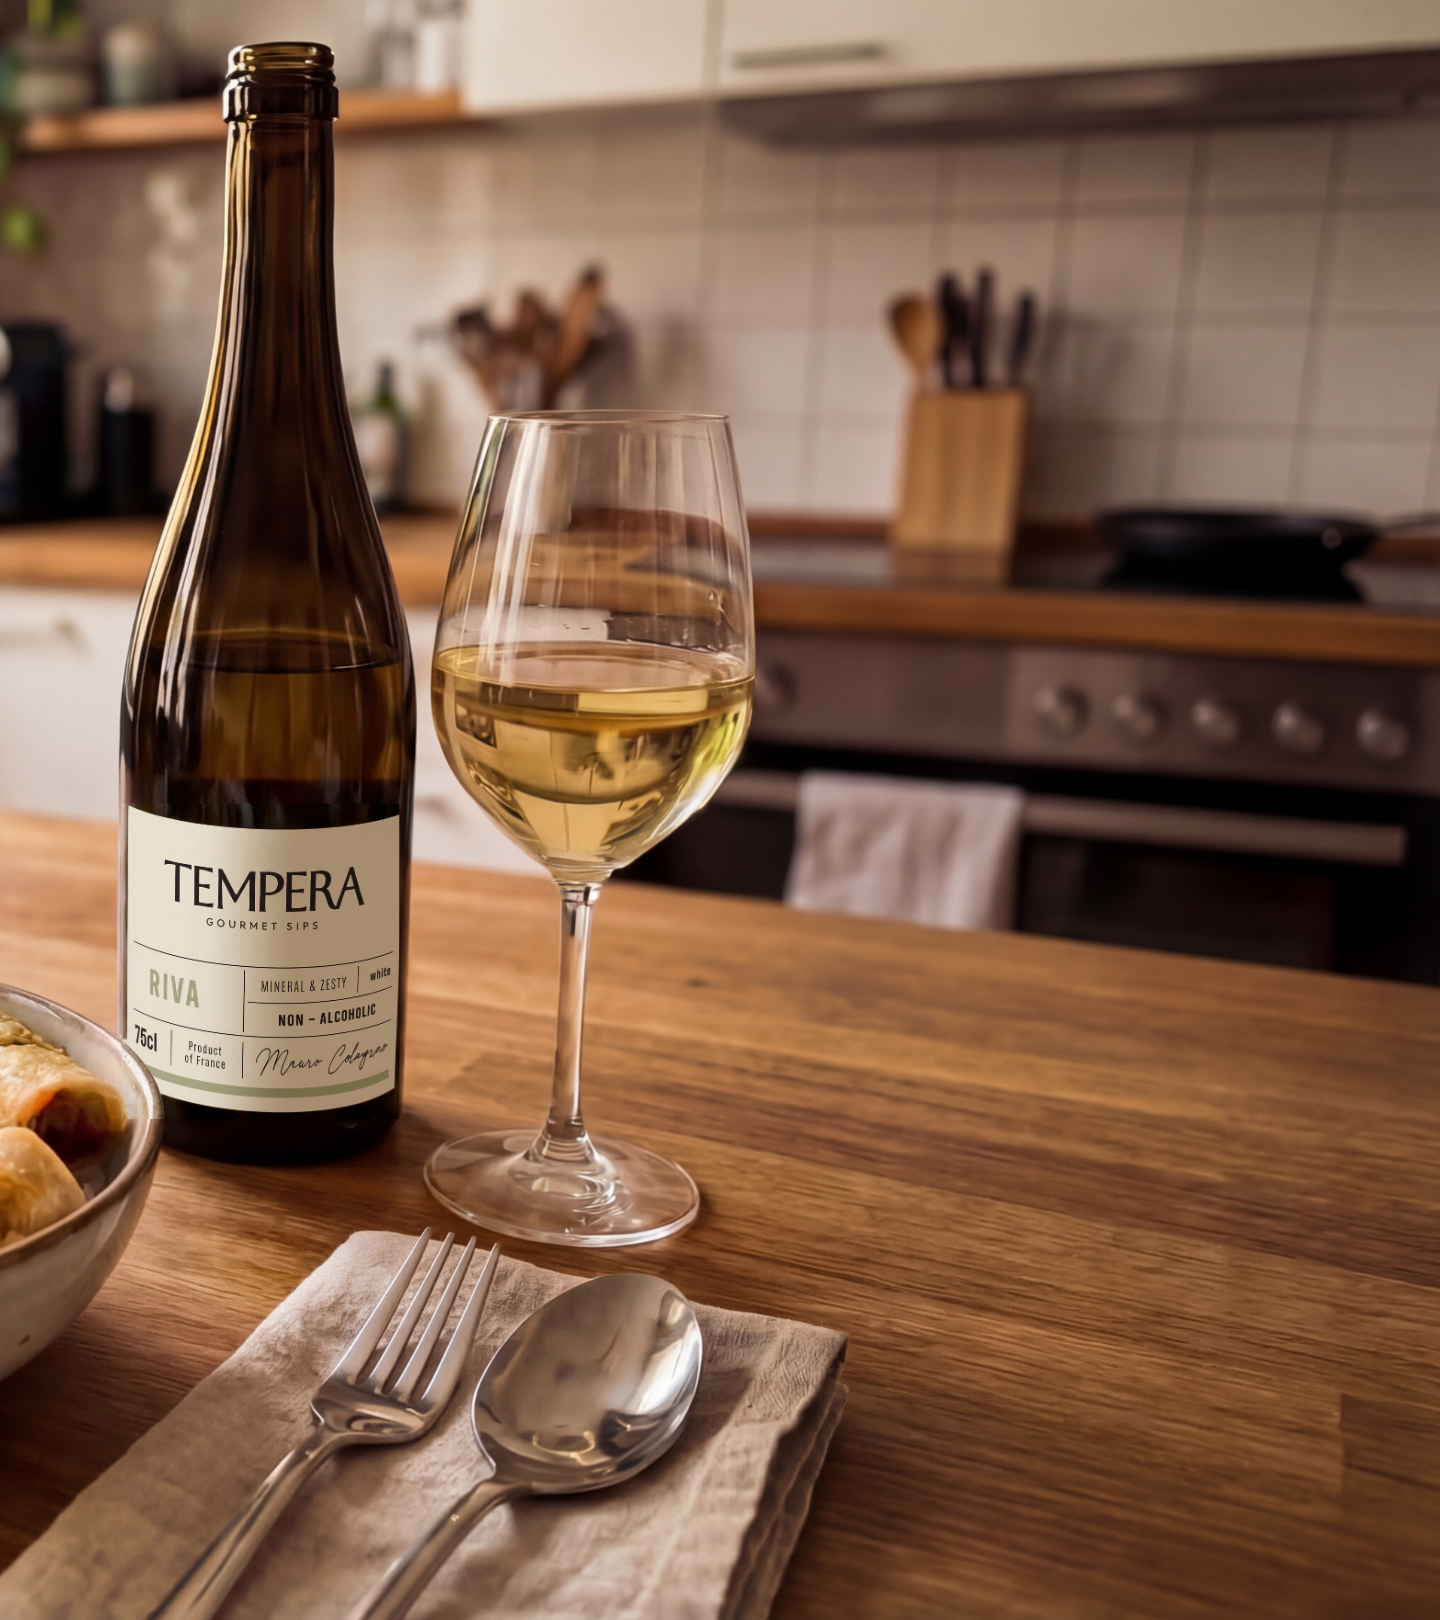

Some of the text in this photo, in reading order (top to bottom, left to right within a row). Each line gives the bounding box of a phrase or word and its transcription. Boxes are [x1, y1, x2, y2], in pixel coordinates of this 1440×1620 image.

[164, 859, 365, 913] TEMPERA
[206, 917, 319, 931] GOURMET SIPS
[370, 967, 391, 981] white
[149, 968, 200, 1008] RIVA
[260, 976, 347, 993] MINERAL & ZESTY
[278, 1014, 304, 1027] NON
[319, 1003, 376, 1025] ALCOHOLIC
[134, 1023, 158, 1052] 75cl
[188, 1040, 222, 1057] Product
[184, 1054, 226, 1070] of France
[255, 1047, 323, 1077] Mauro
